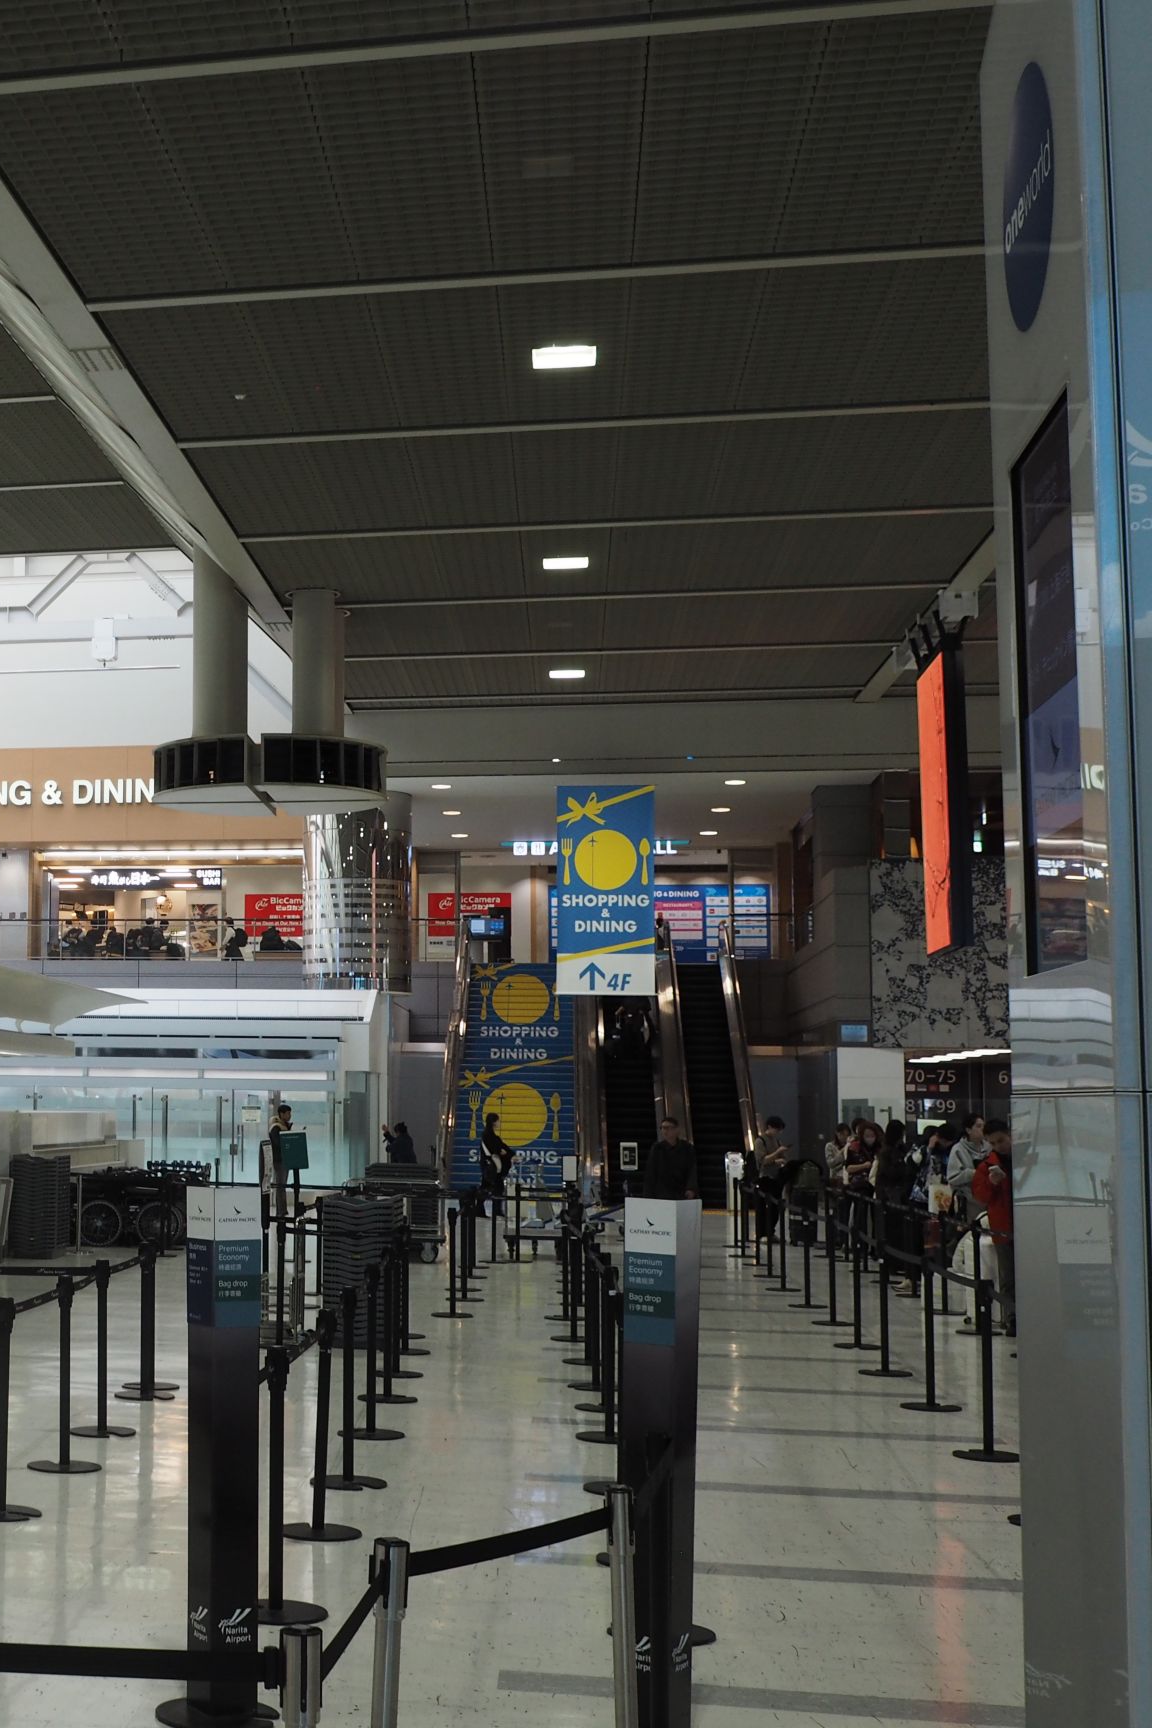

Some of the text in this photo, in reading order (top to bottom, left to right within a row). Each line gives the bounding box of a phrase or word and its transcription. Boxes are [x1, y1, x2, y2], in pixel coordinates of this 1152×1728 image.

[1004, 128, 1051, 254] oneworld
[41, 779, 64, 806] &
[196, 869, 221, 878] SUSHI
[202, 877, 221, 886] BAR
[668, 890, 700, 898] DINING
[460, 895, 501, 904] icCamera
[561, 894, 650, 907] SHOPPING
[600, 908, 611, 918] &
[574, 920, 638, 933] DINING
[607, 973, 633, 991] 4F
[480, 1026, 559, 1038] SHOPPING
[514, 1037, 523, 1046] &
[490, 1048, 547, 1060] DINING
[469, 1150, 558, 1164] SPING
[218, 1244, 250, 1253] Premium
[218, 1253, 250, 1262] Economy
[628, 1256, 663, 1267] Premium
[628, 1265, 663, 1277] Economy
[218, 1279, 248, 1289] Bag drop
[628, 1292, 662, 1303] Bag drop
[225, 1626, 248, 1635] Narita
[225, 1634, 251, 1644] Airport
